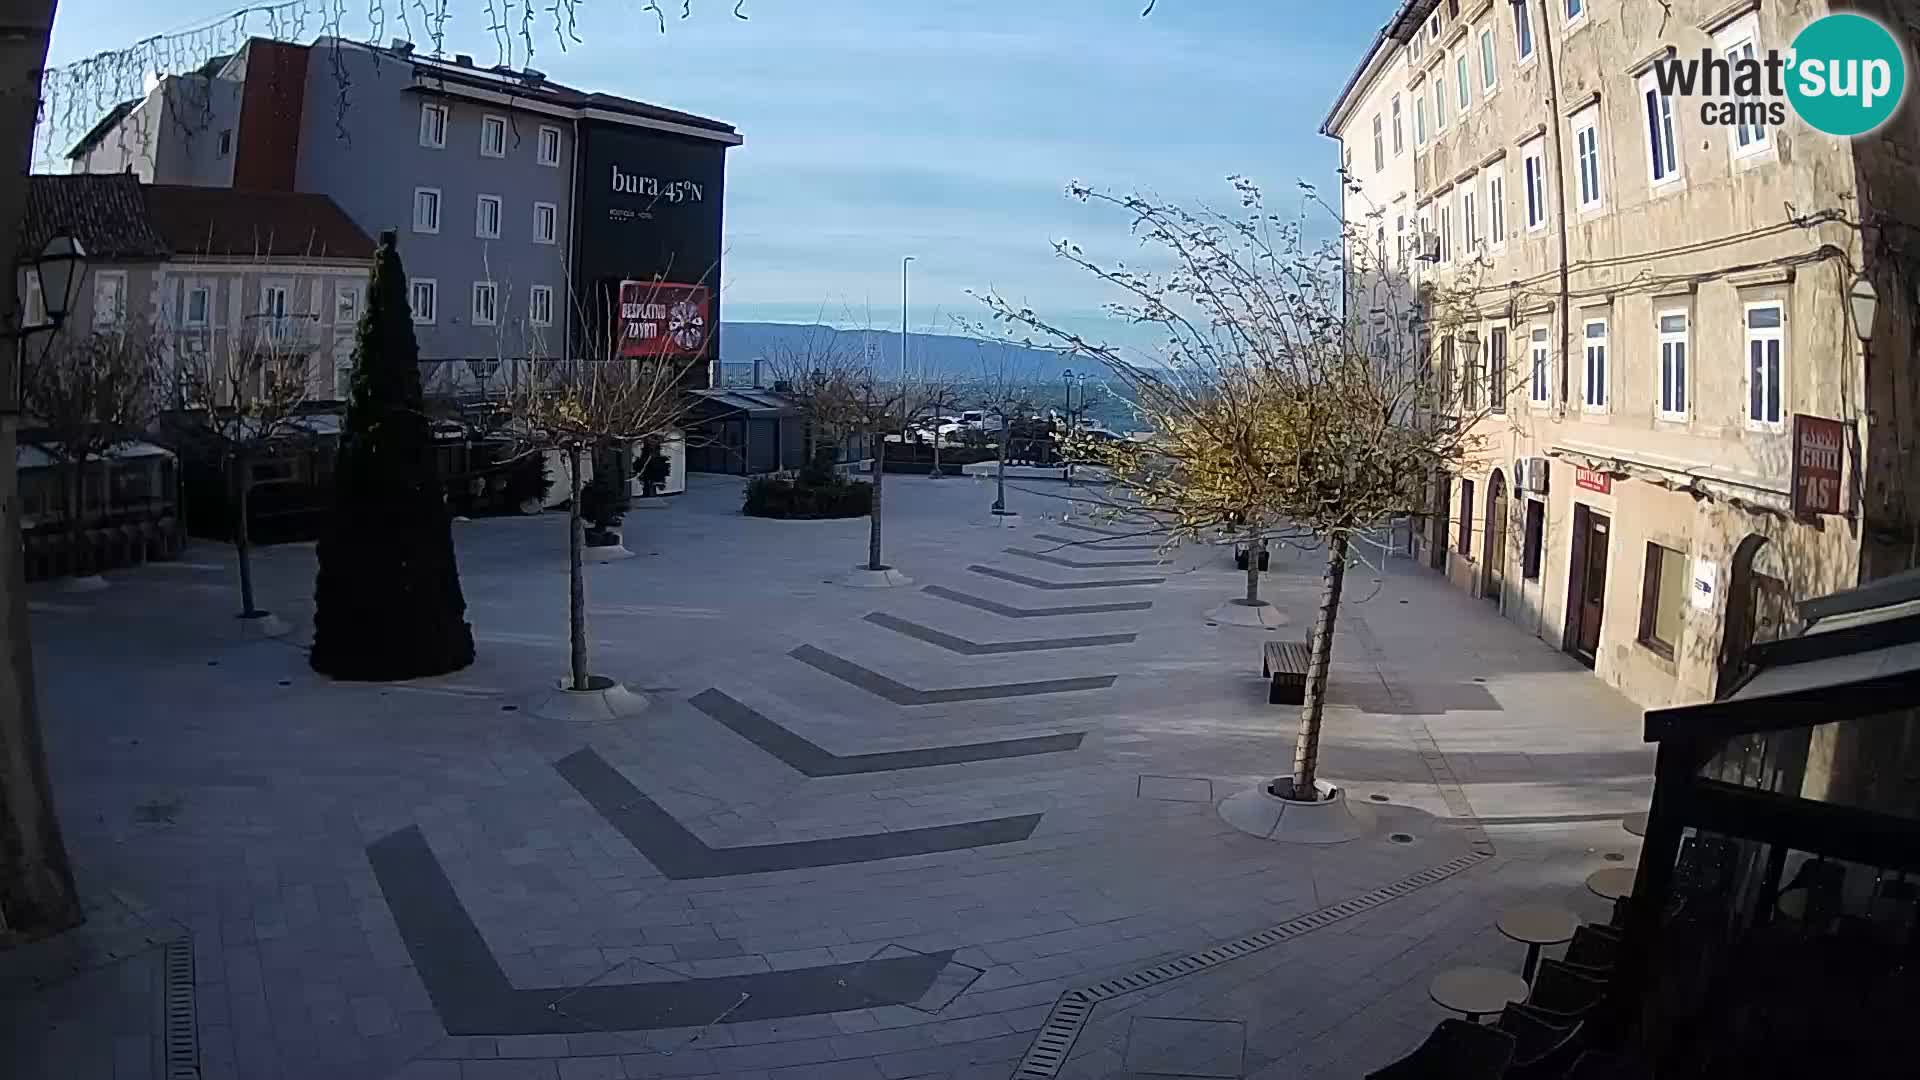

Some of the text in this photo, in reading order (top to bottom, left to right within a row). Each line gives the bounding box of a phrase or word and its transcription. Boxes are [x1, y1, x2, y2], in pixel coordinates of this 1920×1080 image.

[612, 165, 658, 196] bura
[622, 303, 667, 320] BESPLATNO
[628, 321, 658, 339] ZAVRTI
[1800, 447, 1839, 471] GRILL
